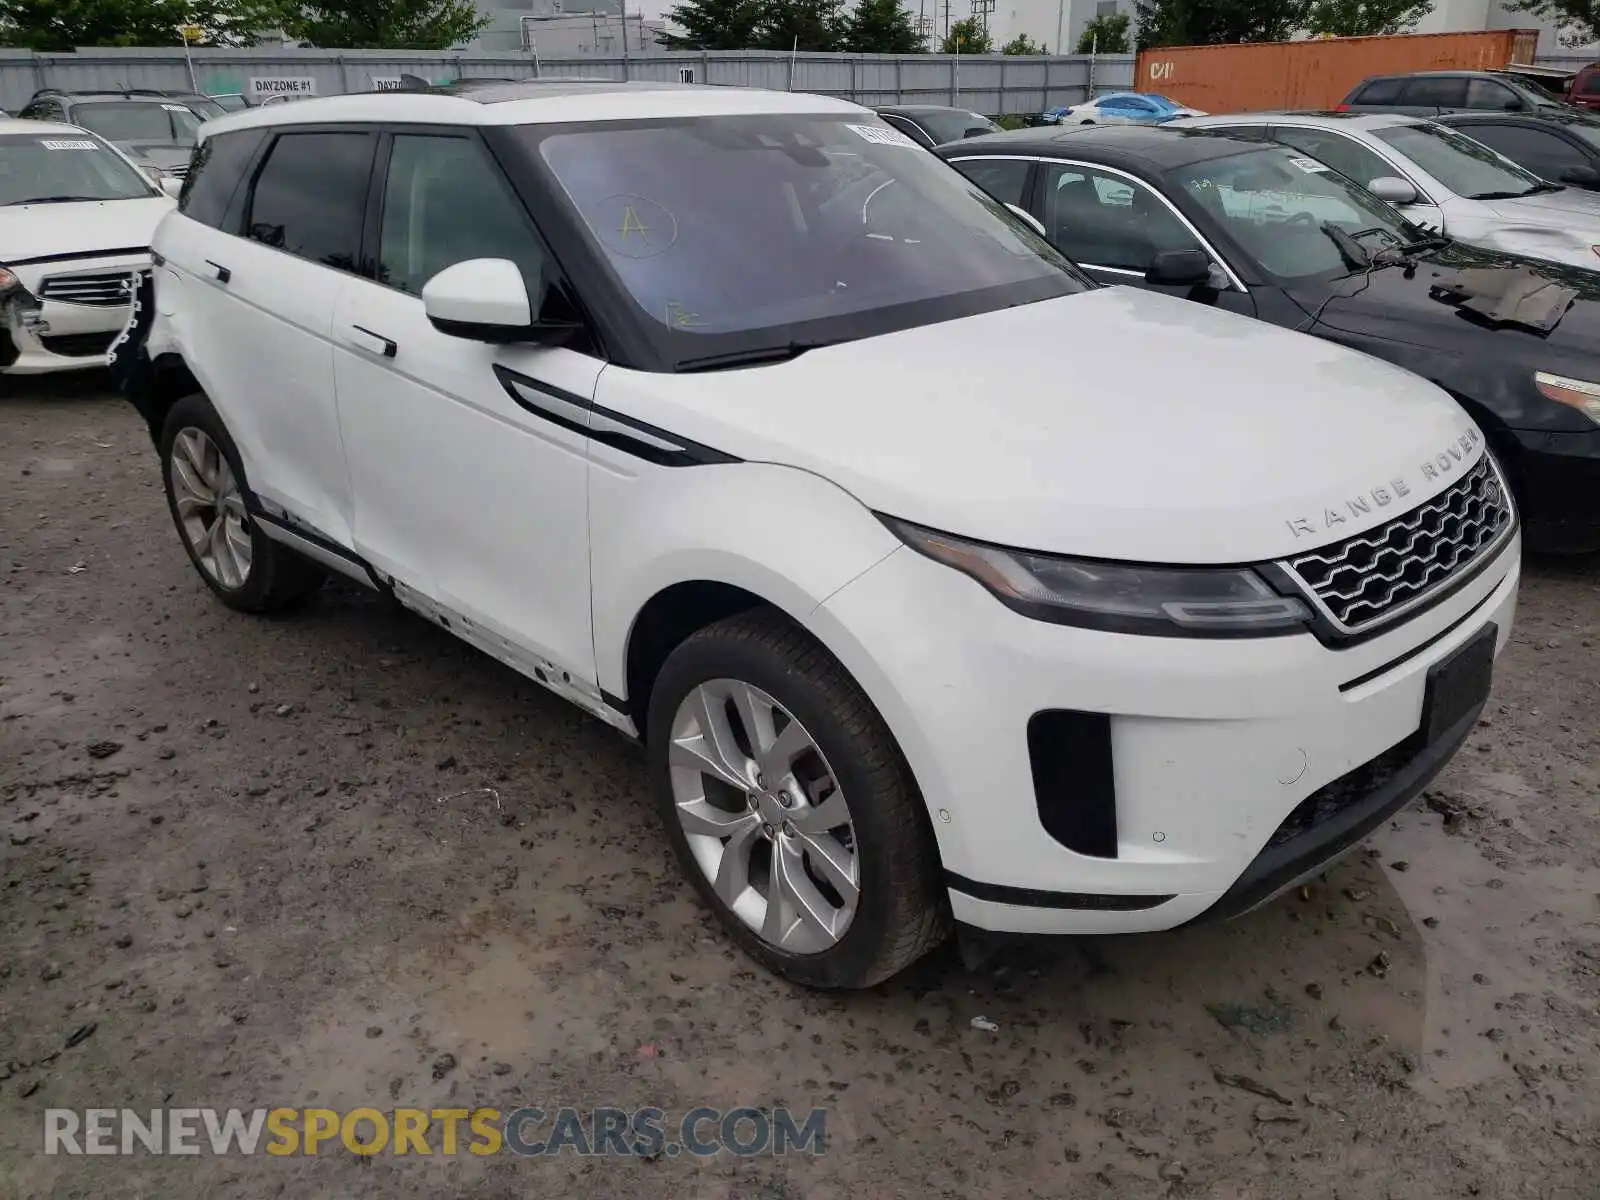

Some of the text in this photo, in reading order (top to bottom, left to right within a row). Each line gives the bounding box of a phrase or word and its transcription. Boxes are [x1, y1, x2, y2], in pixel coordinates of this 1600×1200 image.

[255, 80, 311, 91] DAYZONE #1
[1286, 428, 1480, 537] RANGE ROVER
